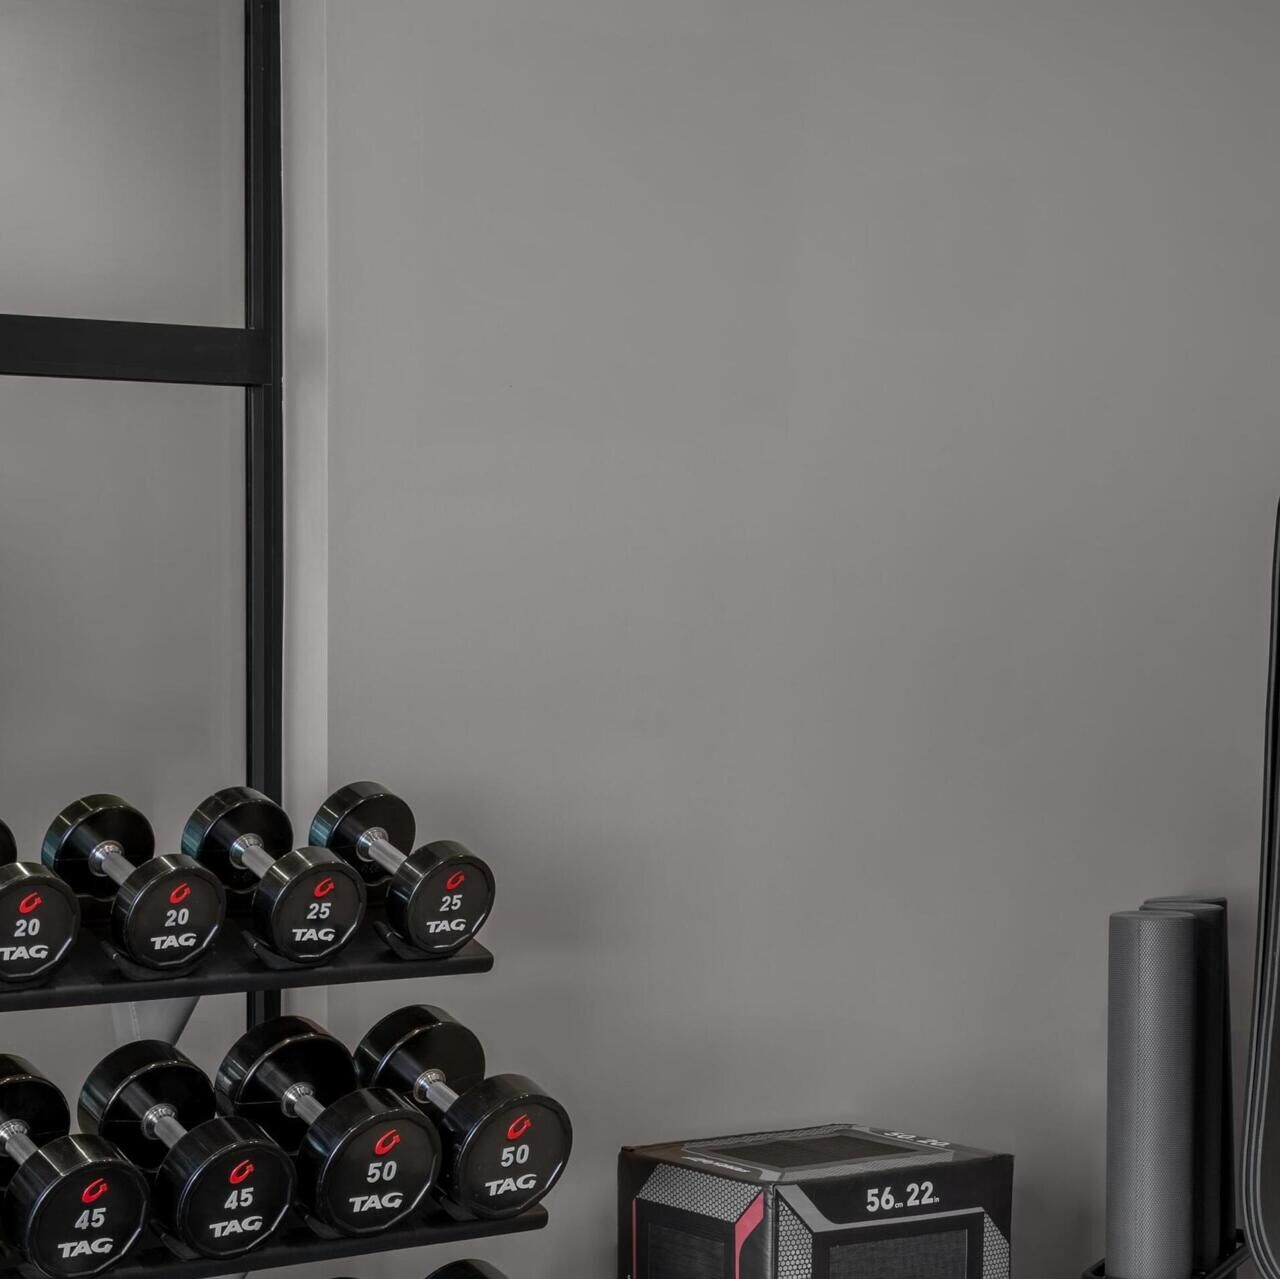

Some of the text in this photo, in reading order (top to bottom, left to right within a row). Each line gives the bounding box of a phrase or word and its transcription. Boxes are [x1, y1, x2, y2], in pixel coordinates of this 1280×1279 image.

[306, 902, 332, 920] 25
[439, 894, 463, 912] 25
[13, 918, 41, 938] 20
[164, 907, 190, 928] 20
[425, 918, 467, 934] TAG
[150, 932, 197, 950] TAG
[291, 927, 336, 942] TAG
[500, 1143, 530, 1168] 50
[366, 1160, 398, 1184] 50
[484, 1173, 537, 1197] TAG
[223, 1186, 254, 1210] 45
[348, 1191, 404, 1213] TAG
[74, 1207, 107, 1230] 45
[208, 1215, 263, 1238] TAG
[57, 1237, 114, 1259] TAG
